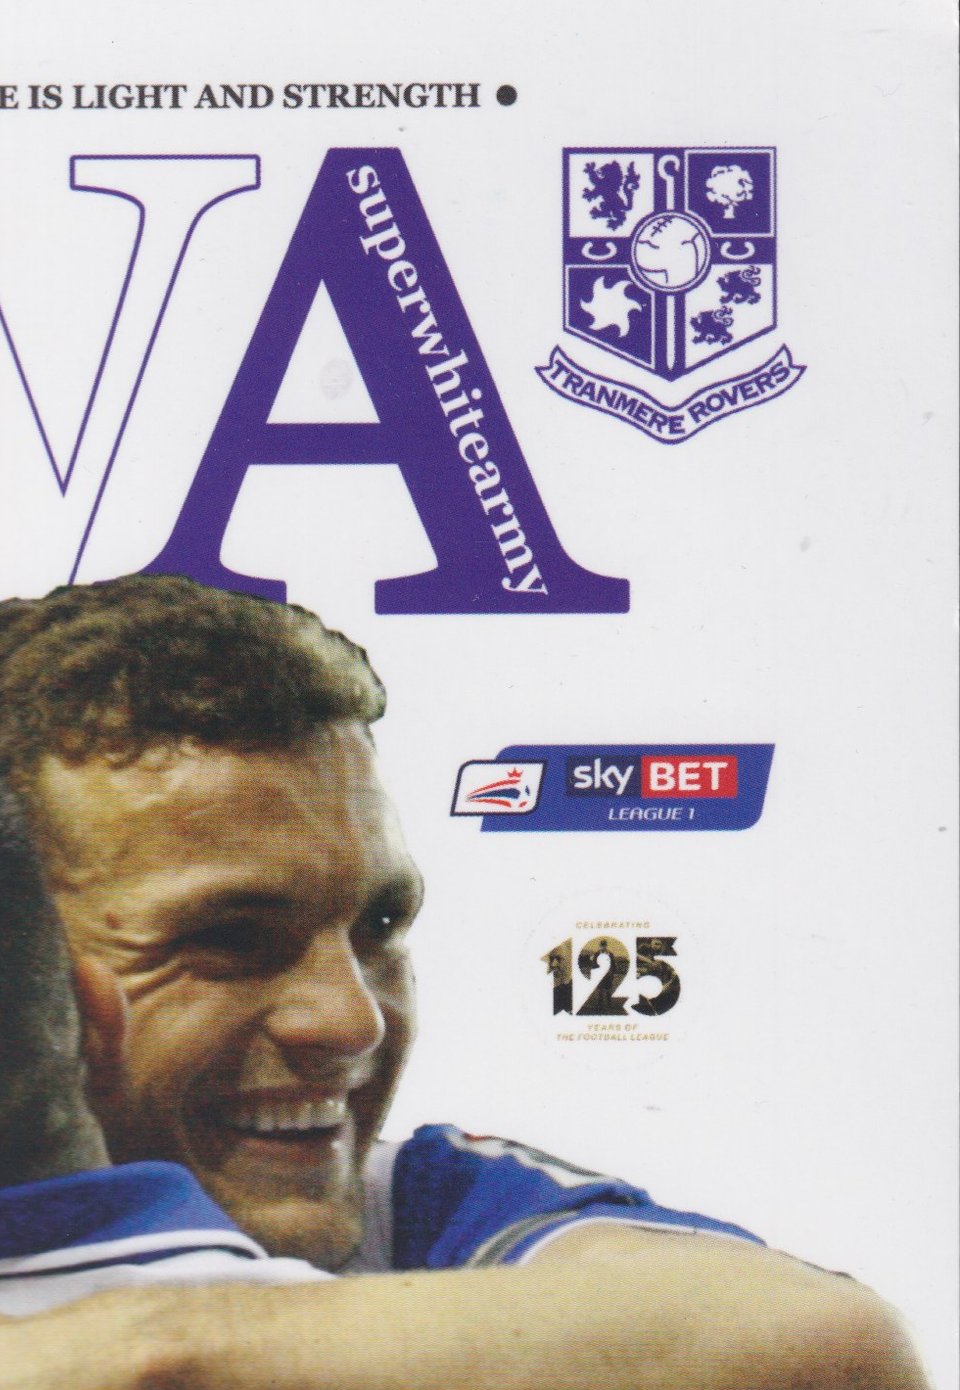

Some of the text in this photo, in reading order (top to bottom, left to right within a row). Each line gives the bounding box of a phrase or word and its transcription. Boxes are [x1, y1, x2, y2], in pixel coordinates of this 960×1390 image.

[28, 84, 63, 110] IS
[72, 84, 187, 109] LIGHT
[194, 84, 274, 109] AND
[283, 83, 480, 109] STRENGTH
[347, 165, 548, 595] superwhitearmy
[551, 360, 790, 434] TRANMERE ROVERS
[573, 758, 729, 795] sky BET
[607, 807, 696, 822] LEAGUE 1
[575, 920, 651, 930] CELEBRATING
[540, 936, 681, 1017] 125
